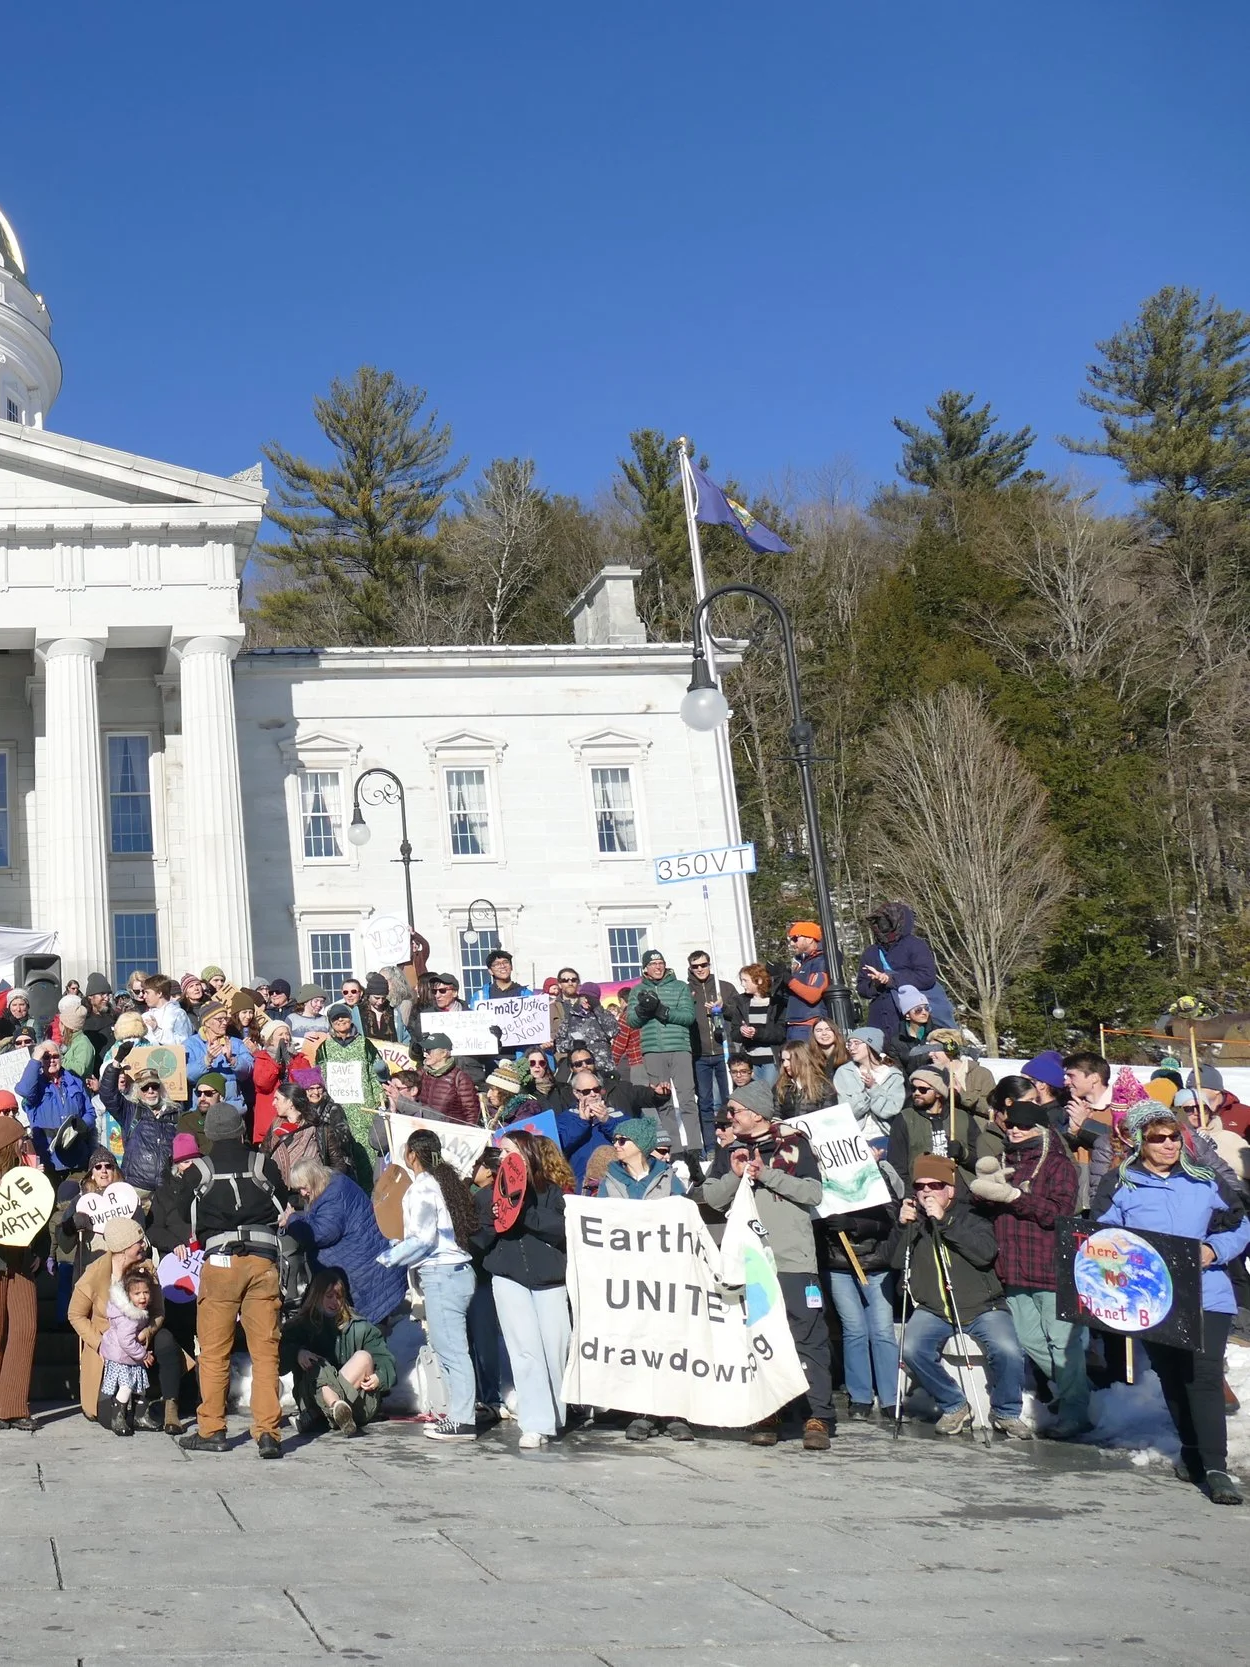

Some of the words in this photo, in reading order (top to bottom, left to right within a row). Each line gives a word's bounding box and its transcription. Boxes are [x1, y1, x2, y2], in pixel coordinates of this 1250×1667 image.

[658, 848, 750, 880] 350VT
[501, 1011, 541, 1041] gether
[513, 1021, 545, 1044] Now
[331, 1064, 355, 1076] SAVE
[87, 1199, 98, 1212] U
[107, 1192, 118, 1205] R
[90, 1204, 134, 1226] OWERFUL
[1072, 1231, 1119, 1260] There
[1104, 1270, 1128, 1288] NO
[1076, 1293, 1128, 1322] Planet
[1138, 1308, 1150, 1328] B
